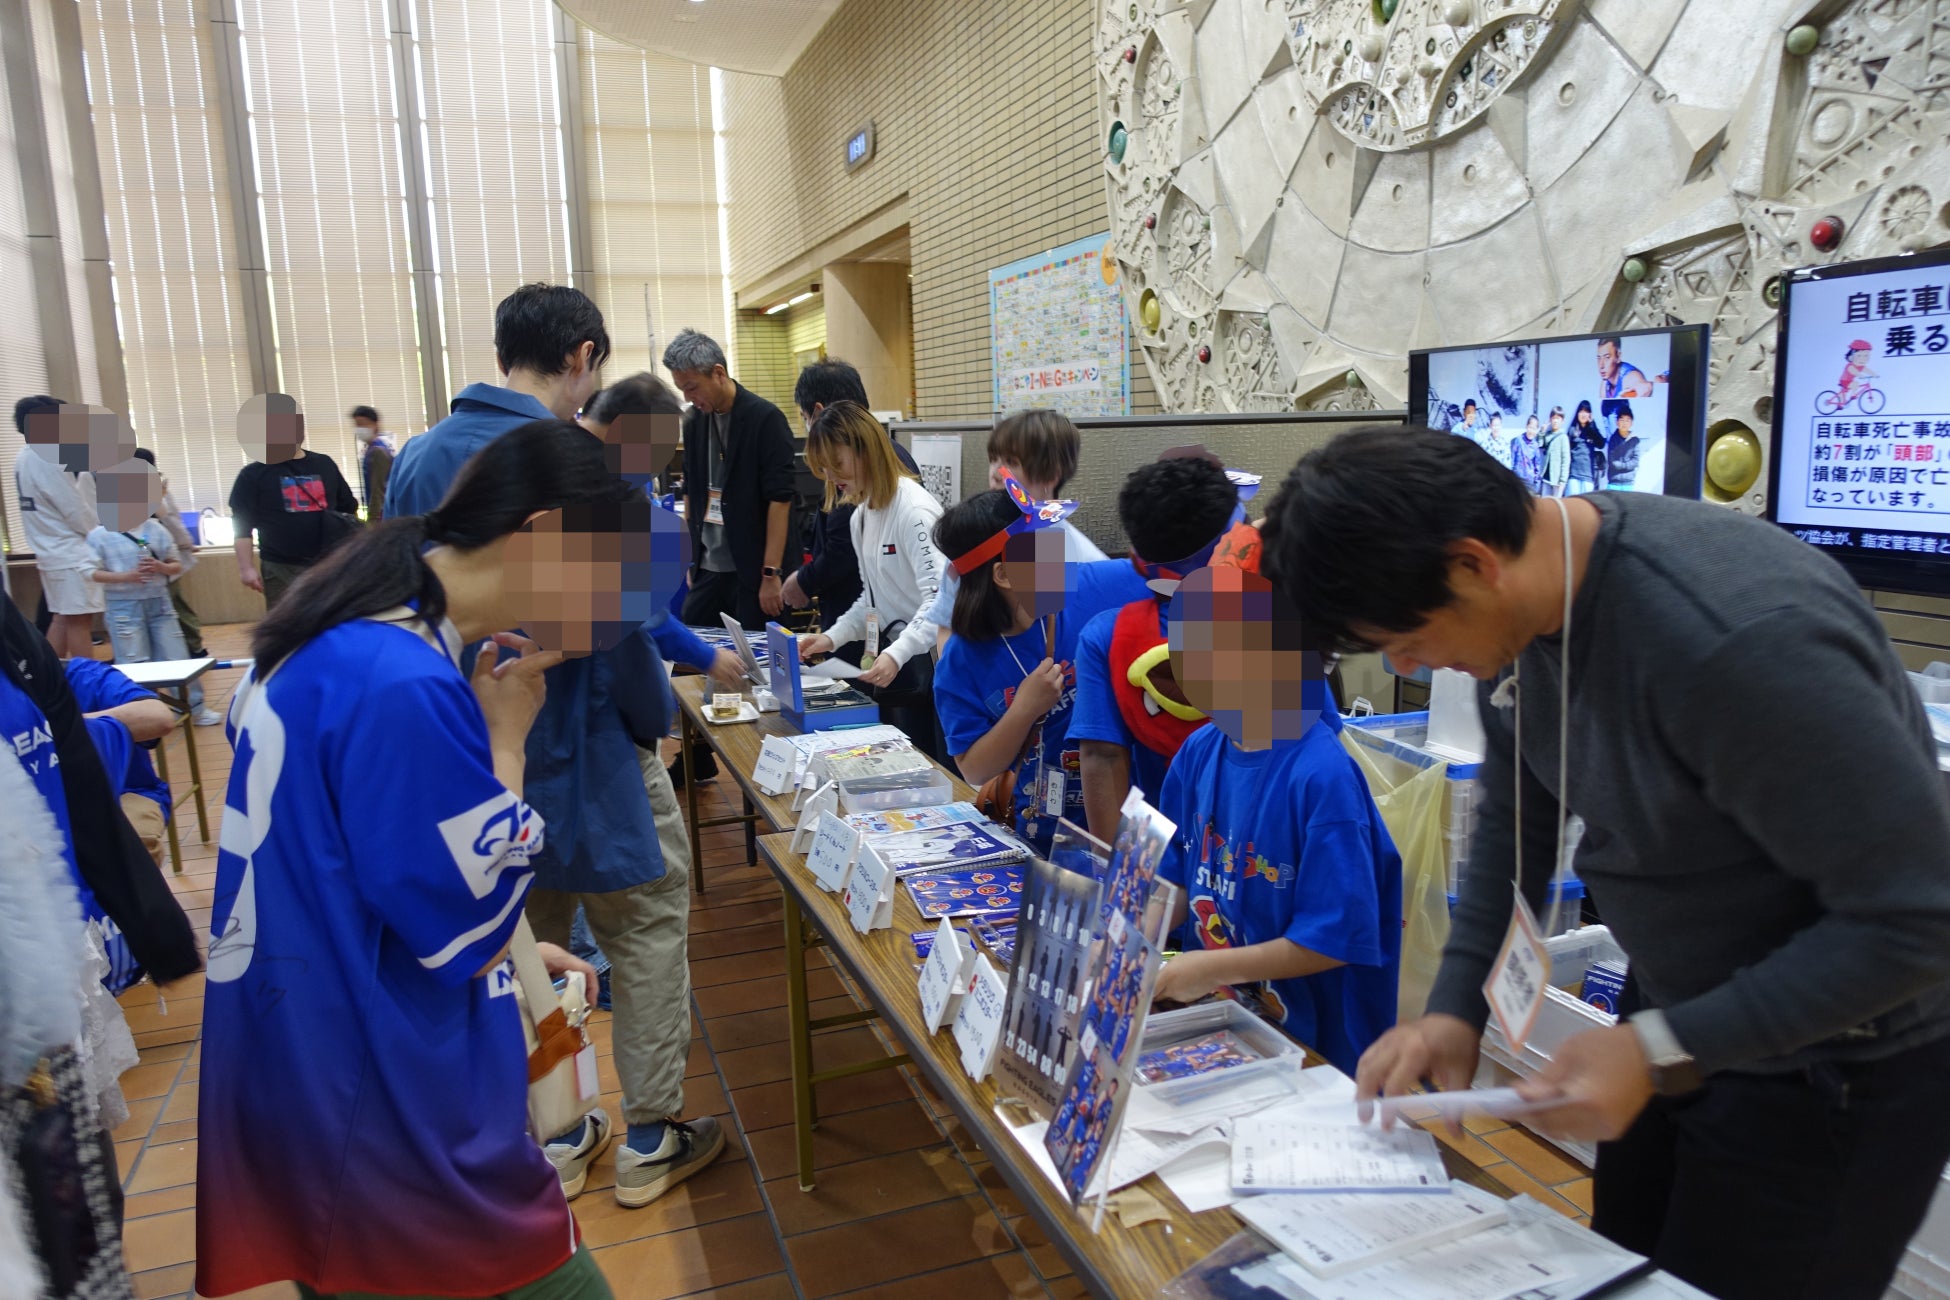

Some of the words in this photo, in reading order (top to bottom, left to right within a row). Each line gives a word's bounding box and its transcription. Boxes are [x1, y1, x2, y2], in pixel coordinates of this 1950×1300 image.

[1847, 284, 1950, 322] 自転車
[1885, 324, 1949, 356] 乗る
[1817, 421, 1950, 439] 自転車死亡事故
[1814, 443, 1950, 463] 約7割が「頭部」
[1812, 488, 1935, 509] なっています。
[914, 520, 938, 582] TOMMY
